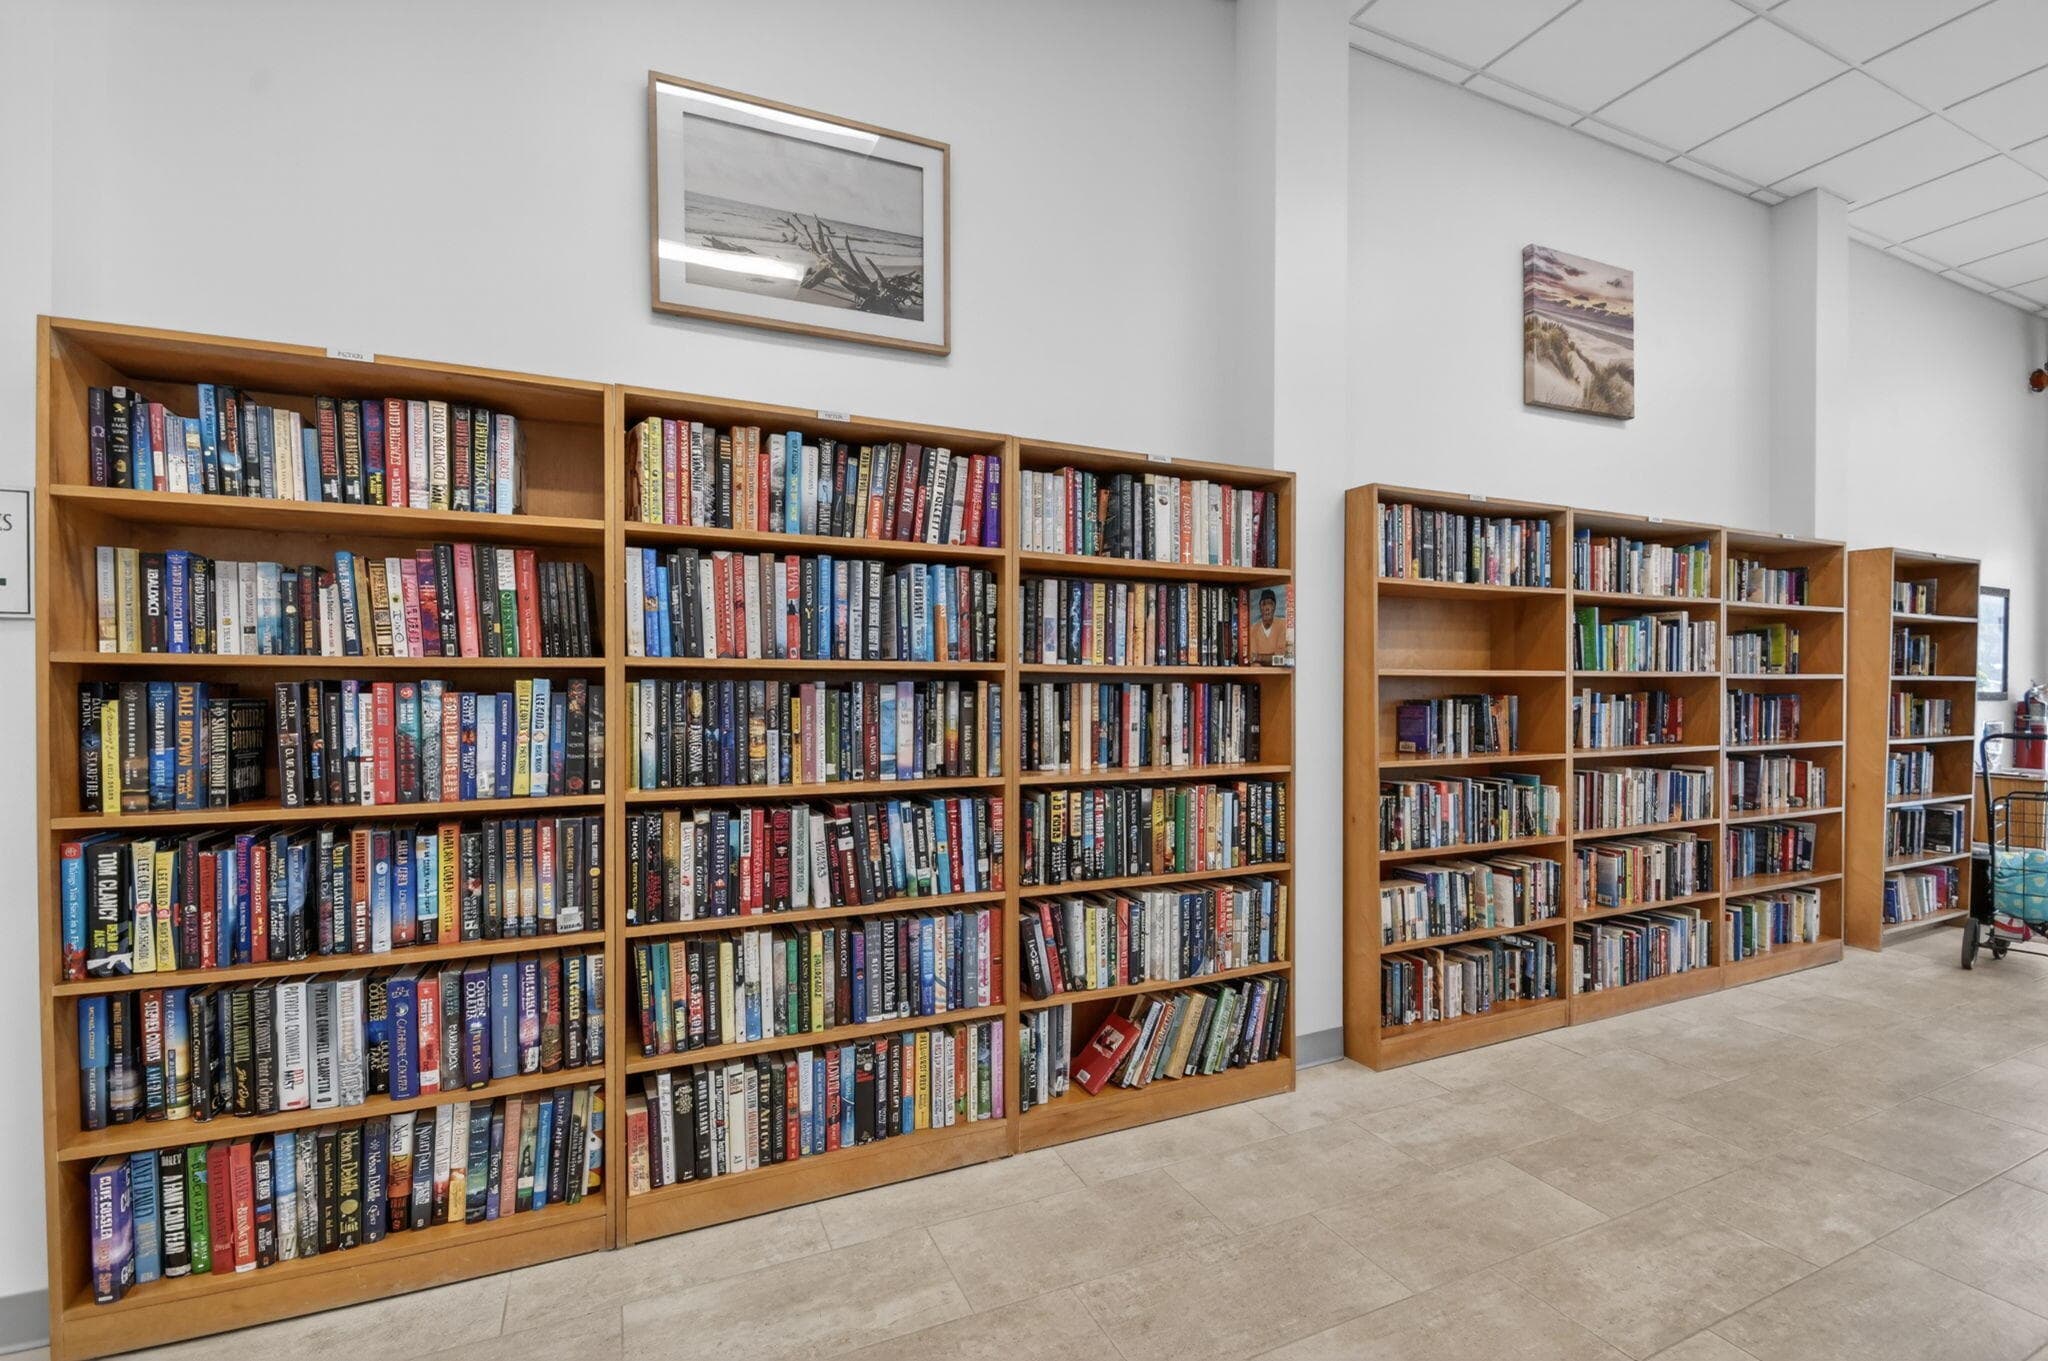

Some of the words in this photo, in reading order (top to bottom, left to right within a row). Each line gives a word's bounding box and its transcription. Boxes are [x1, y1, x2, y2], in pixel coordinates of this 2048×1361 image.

[147, 572, 160, 616] BALDACCI
[178, 686, 193, 717] DALE
[178, 720, 193, 766] BROWN
[443, 829, 453, 862] HARLAN
[98, 852, 118, 876] TOM
[138, 858, 149, 872] LEE
[157, 868, 168, 882] LEE
[443, 865, 453, 892] COBEN
[98, 879, 118, 922] CLANCY
[138, 875, 150, 899] CHILD
[569, 959, 580, 983] CLIVE
[284, 986, 300, 1022] PATRICIA
[315, 989, 328, 1018] PATRICIA
[569, 984, 580, 1020] CUSSLER
[284, 1025, 300, 1067] CORNWELL
[316, 1019, 329, 1054] CORNWELL
[396, 1019, 407, 1057] CATHERINE
[146, 1066, 161, 1108] AMERICA
[283, 1070, 294, 1090] MIST
[317, 1057, 330, 1094] SCARPETTA
[340, 1131, 358, 1161] Nelson
[392, 1124, 409, 1152] Nelson
[340, 1161, 358, 1196] DeMille
[368, 1152, 382, 1176] Nelson
[99, 1175, 111, 1201] CLIVE
[163, 1184, 182, 1207] FAINT
[100, 1201, 112, 1240] CUSSLER
[165, 1209, 185, 1231] COLD
[194, 1201, 204, 1234] PARTY
[165, 1232, 184, 1255] FEAR
